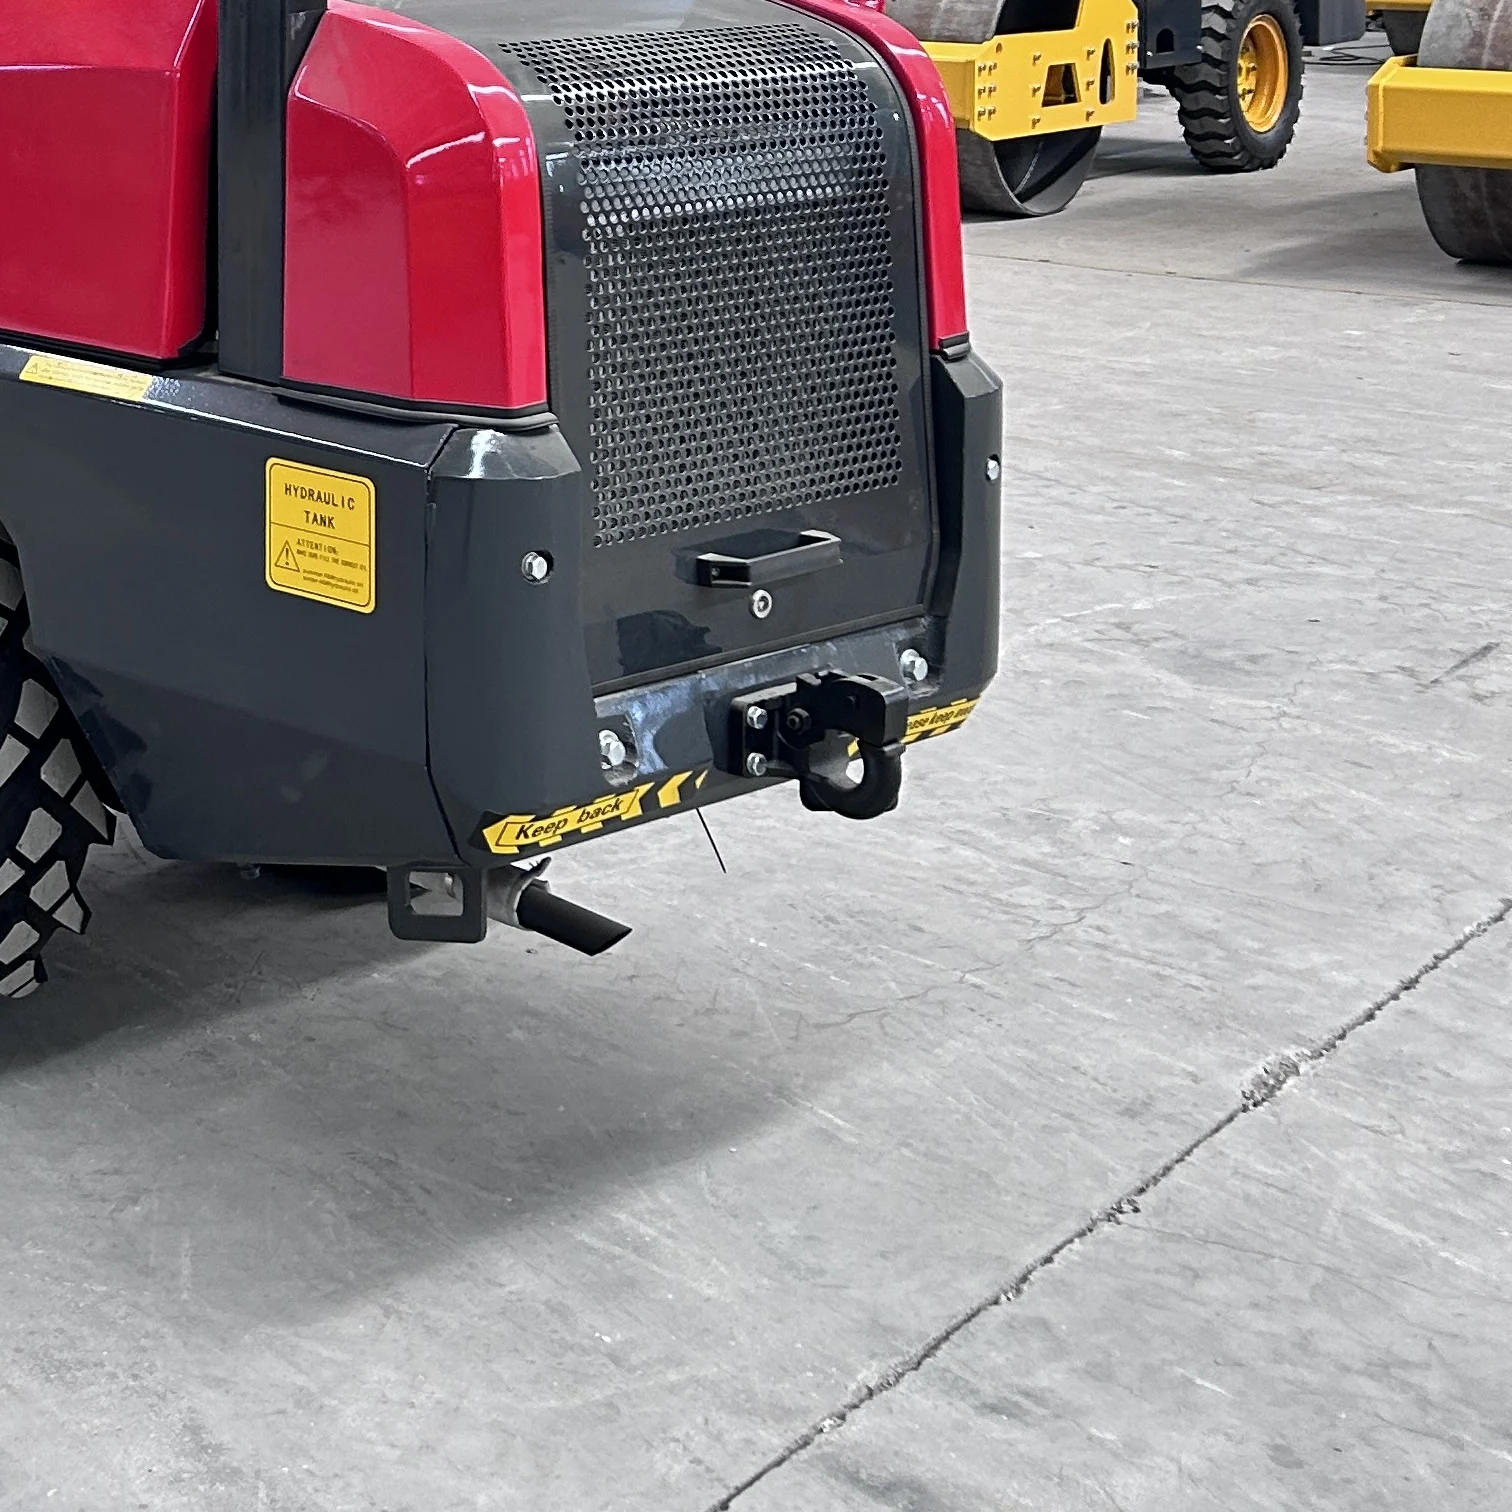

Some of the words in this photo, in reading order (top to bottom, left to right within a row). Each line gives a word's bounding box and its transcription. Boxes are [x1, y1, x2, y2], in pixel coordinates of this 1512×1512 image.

[284, 482, 356, 511] HYDRAULIC
[304, 510, 336, 530] TANK
[515, 818, 568, 841] Keep
[576, 797, 624, 824] back
